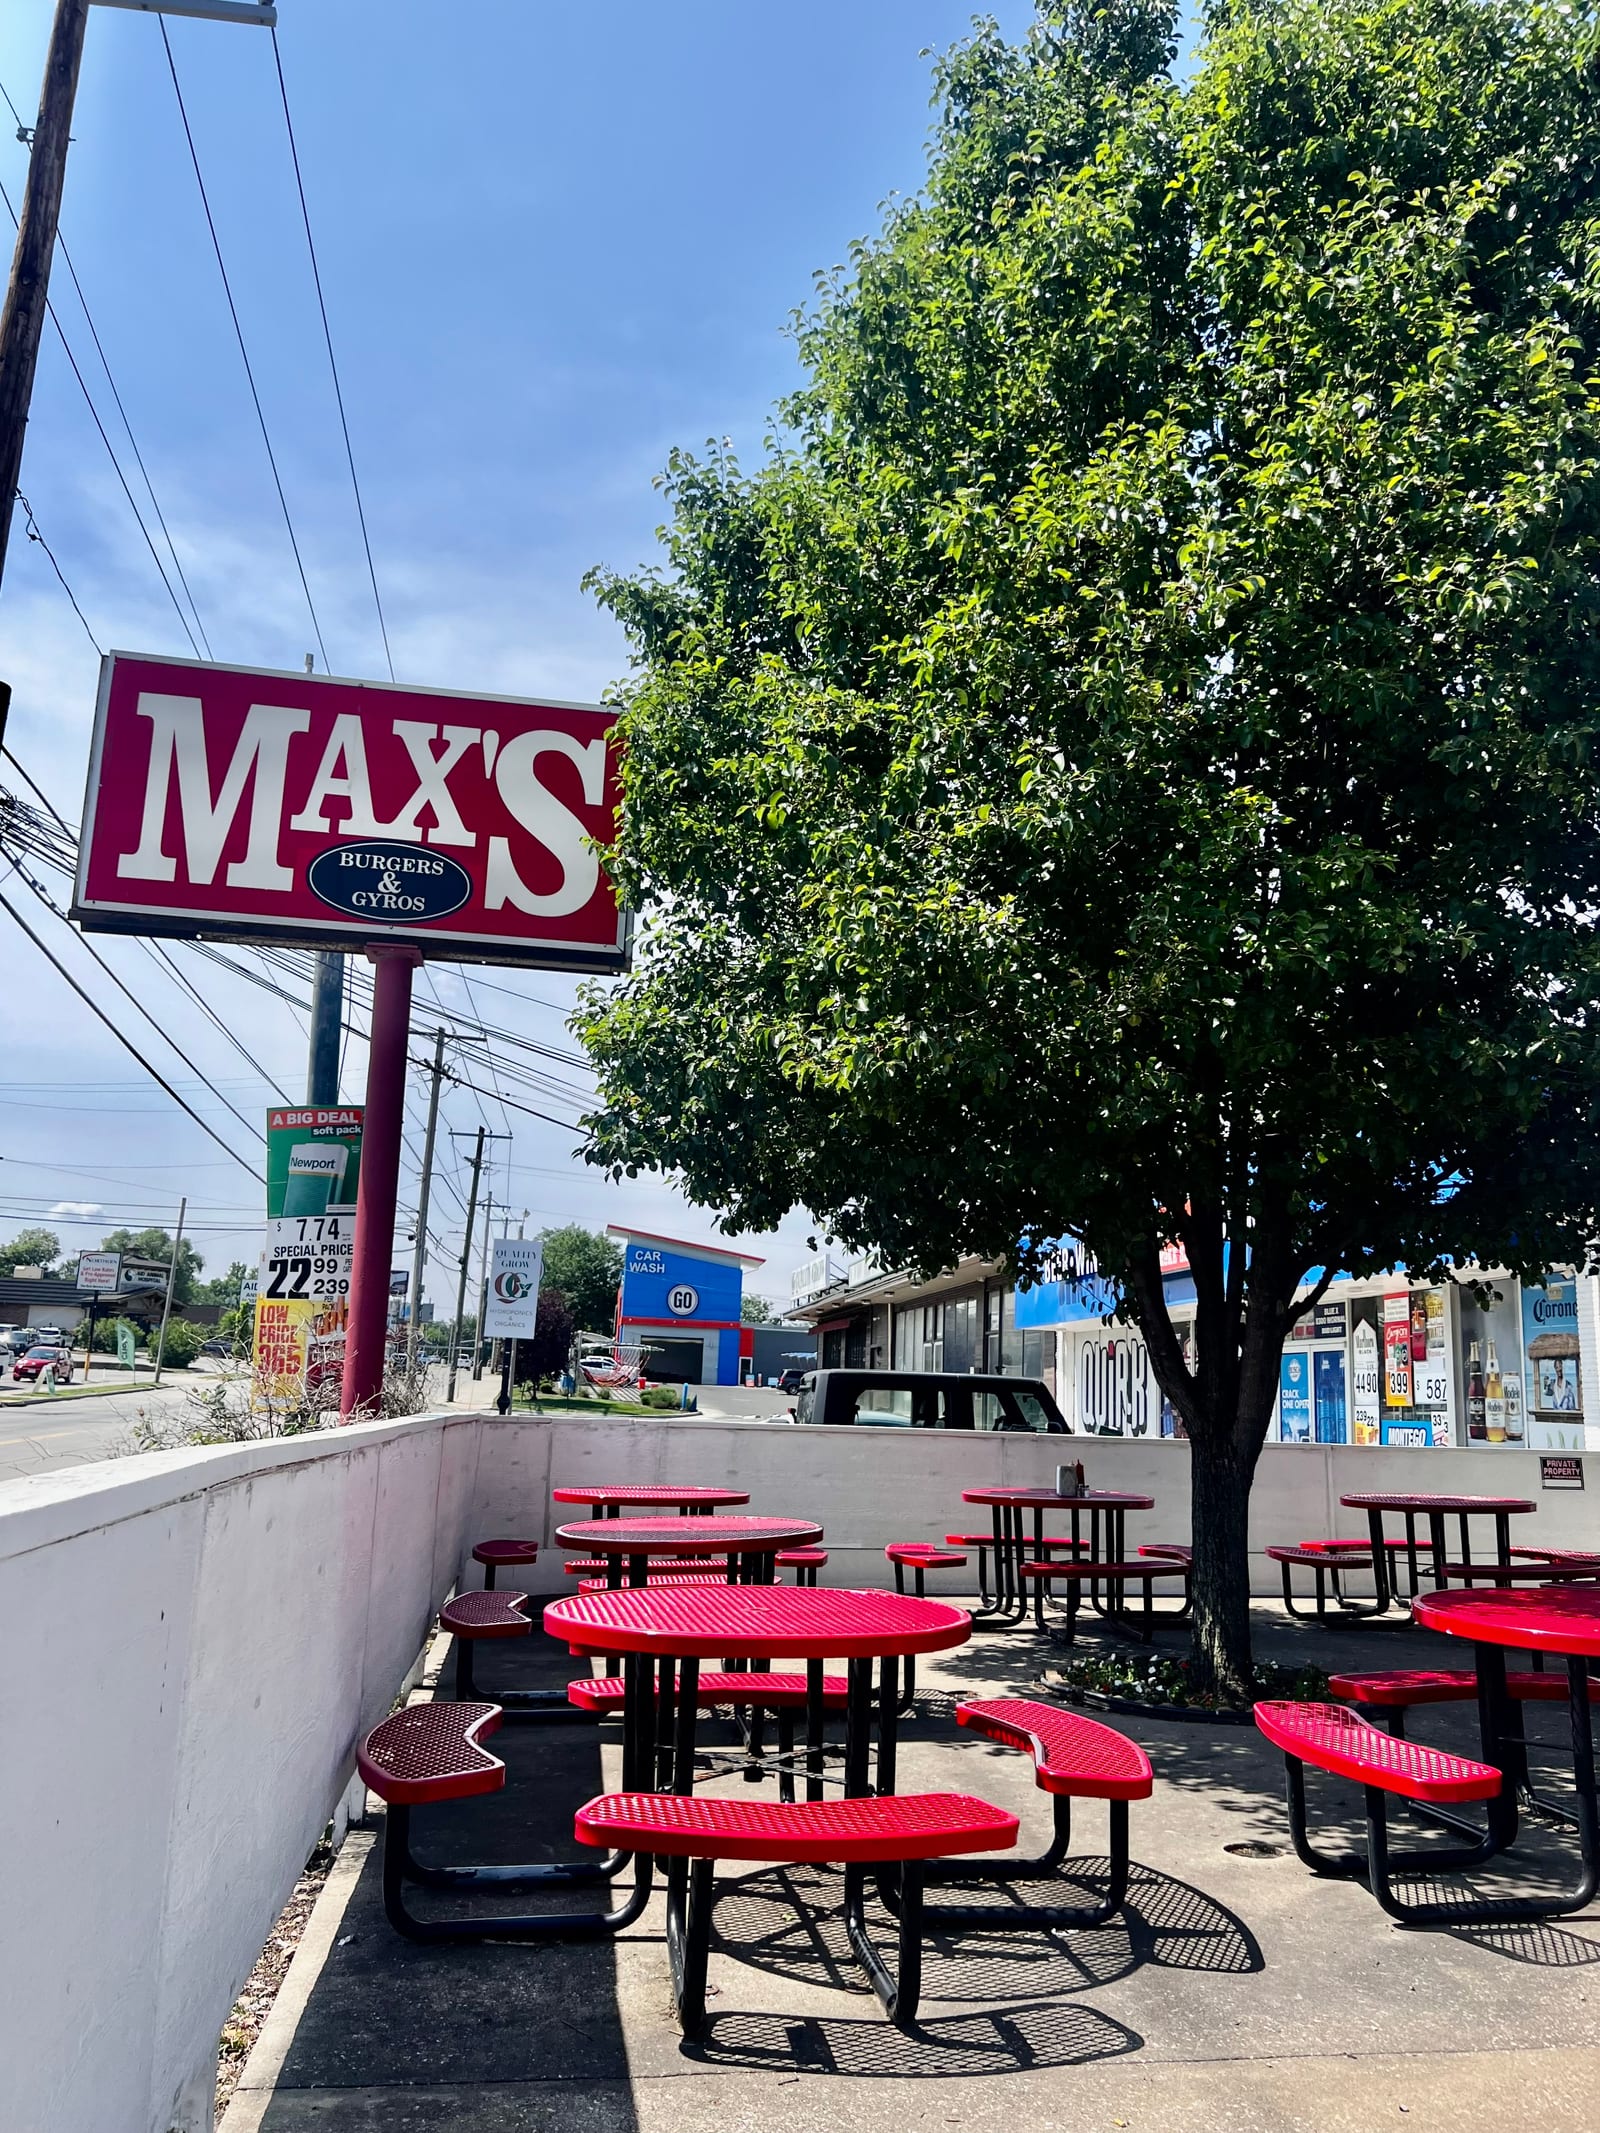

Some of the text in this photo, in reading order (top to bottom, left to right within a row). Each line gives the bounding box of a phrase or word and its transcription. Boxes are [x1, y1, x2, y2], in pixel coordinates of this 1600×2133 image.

[117, 692, 605, 917] MAX'S
[339, 852, 444, 876] BURGERS
[377, 871, 402, 894] &
[351, 891, 425, 912] GYROS
[272, 1112, 358, 1126] A BIG DEAL
[313, 1125, 362, 1136] soft pack
[290, 1157, 336, 1170] Newport
[277, 1222, 282, 1232] $
[296, 1218, 340, 1242] 7.74
[273, 1243, 354, 1258] SPECIAL PRICE
[496, 1249, 537, 1260] QUALITY
[635, 1250, 662, 1261] CAR
[501, 1260, 529, 1268] GROW
[629, 1262, 665, 1274] WASH
[266, 1258, 338, 1300] 22 99
[313, 1278, 349, 1295] 239
[673, 1291, 692, 1309] GO
[260, 1305, 289, 1324] LOW
[258, 1324, 298, 1343] PRICE
[1390, 1372, 1408, 1394] 399
[1282, 1389, 1299, 1399] CRACK
[1282, 1399, 1293, 1409] ONE
[1387, 1426, 1427, 1446] MONTEGO
[1543, 1467, 1580, 1476] PROPERTY
[1546, 1459, 1577, 1468] PRIVATE
